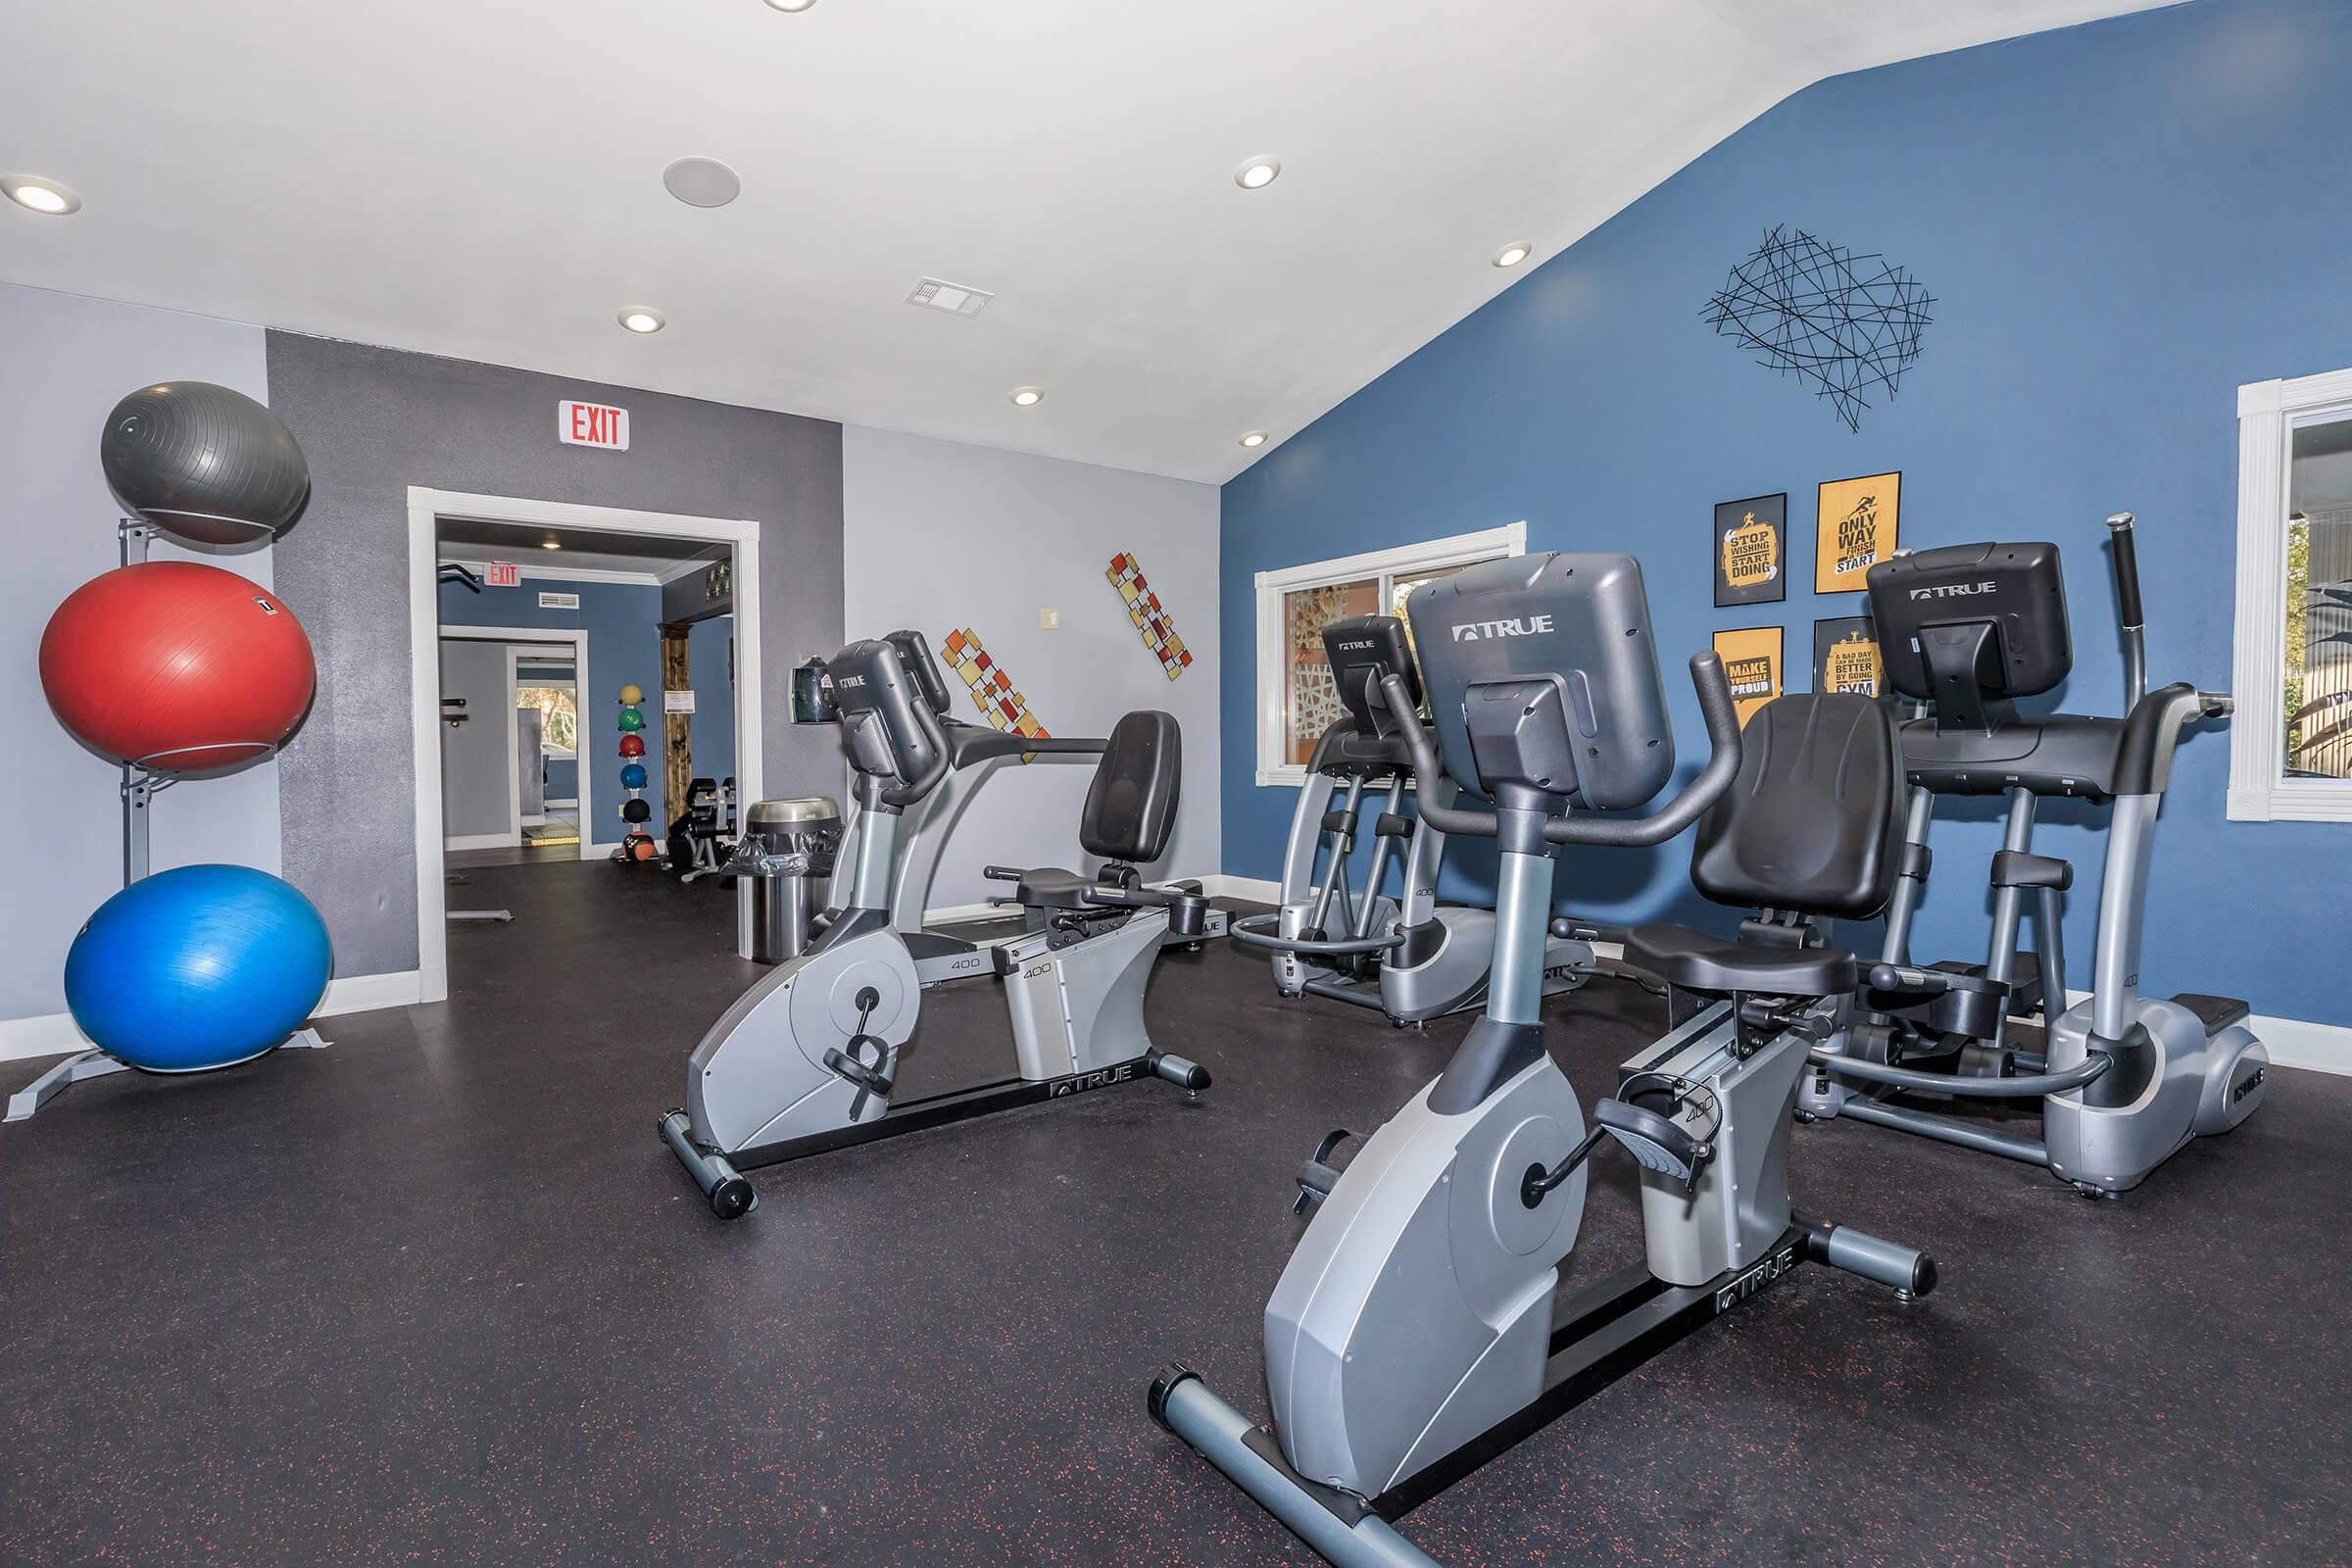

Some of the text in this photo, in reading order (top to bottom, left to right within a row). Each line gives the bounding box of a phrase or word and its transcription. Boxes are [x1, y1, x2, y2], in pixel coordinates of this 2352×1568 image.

[571, 404, 620, 445] EXIT
[1838, 512, 1877, 535] ONLY
[1731, 531, 1768, 547] STOP
[1838, 525, 1876, 549] WAY
[1731, 541, 1769, 556] WISHING
[1846, 540, 1876, 556] FINISH
[1732, 553, 1770, 566] START
[1837, 553, 1875, 573] START
[490, 565, 516, 585] EXIT
[1732, 562, 1771, 578] DOING
[1932, 581, 1997, 598] TRUE
[1477, 614, 1554, 638] TRUE
[1348, 640, 1375, 650] TRUE
[1730, 662, 1767, 677] MAKE
[1836, 662, 1872, 673] BETTER
[1848, 671, 1872, 680] GOING
[847, 675, 866, 688] TRUE
[1730, 674, 1768, 685] YOURSELF
[1731, 681, 1769, 696] PROUD
[952, 958, 980, 969] 400
[1023, 963, 1052, 979] 400
[1071, 1065, 1132, 1091] TRUE
[1686, 1095, 1713, 1122] 400
[1738, 1248, 1792, 1299] TRUE
